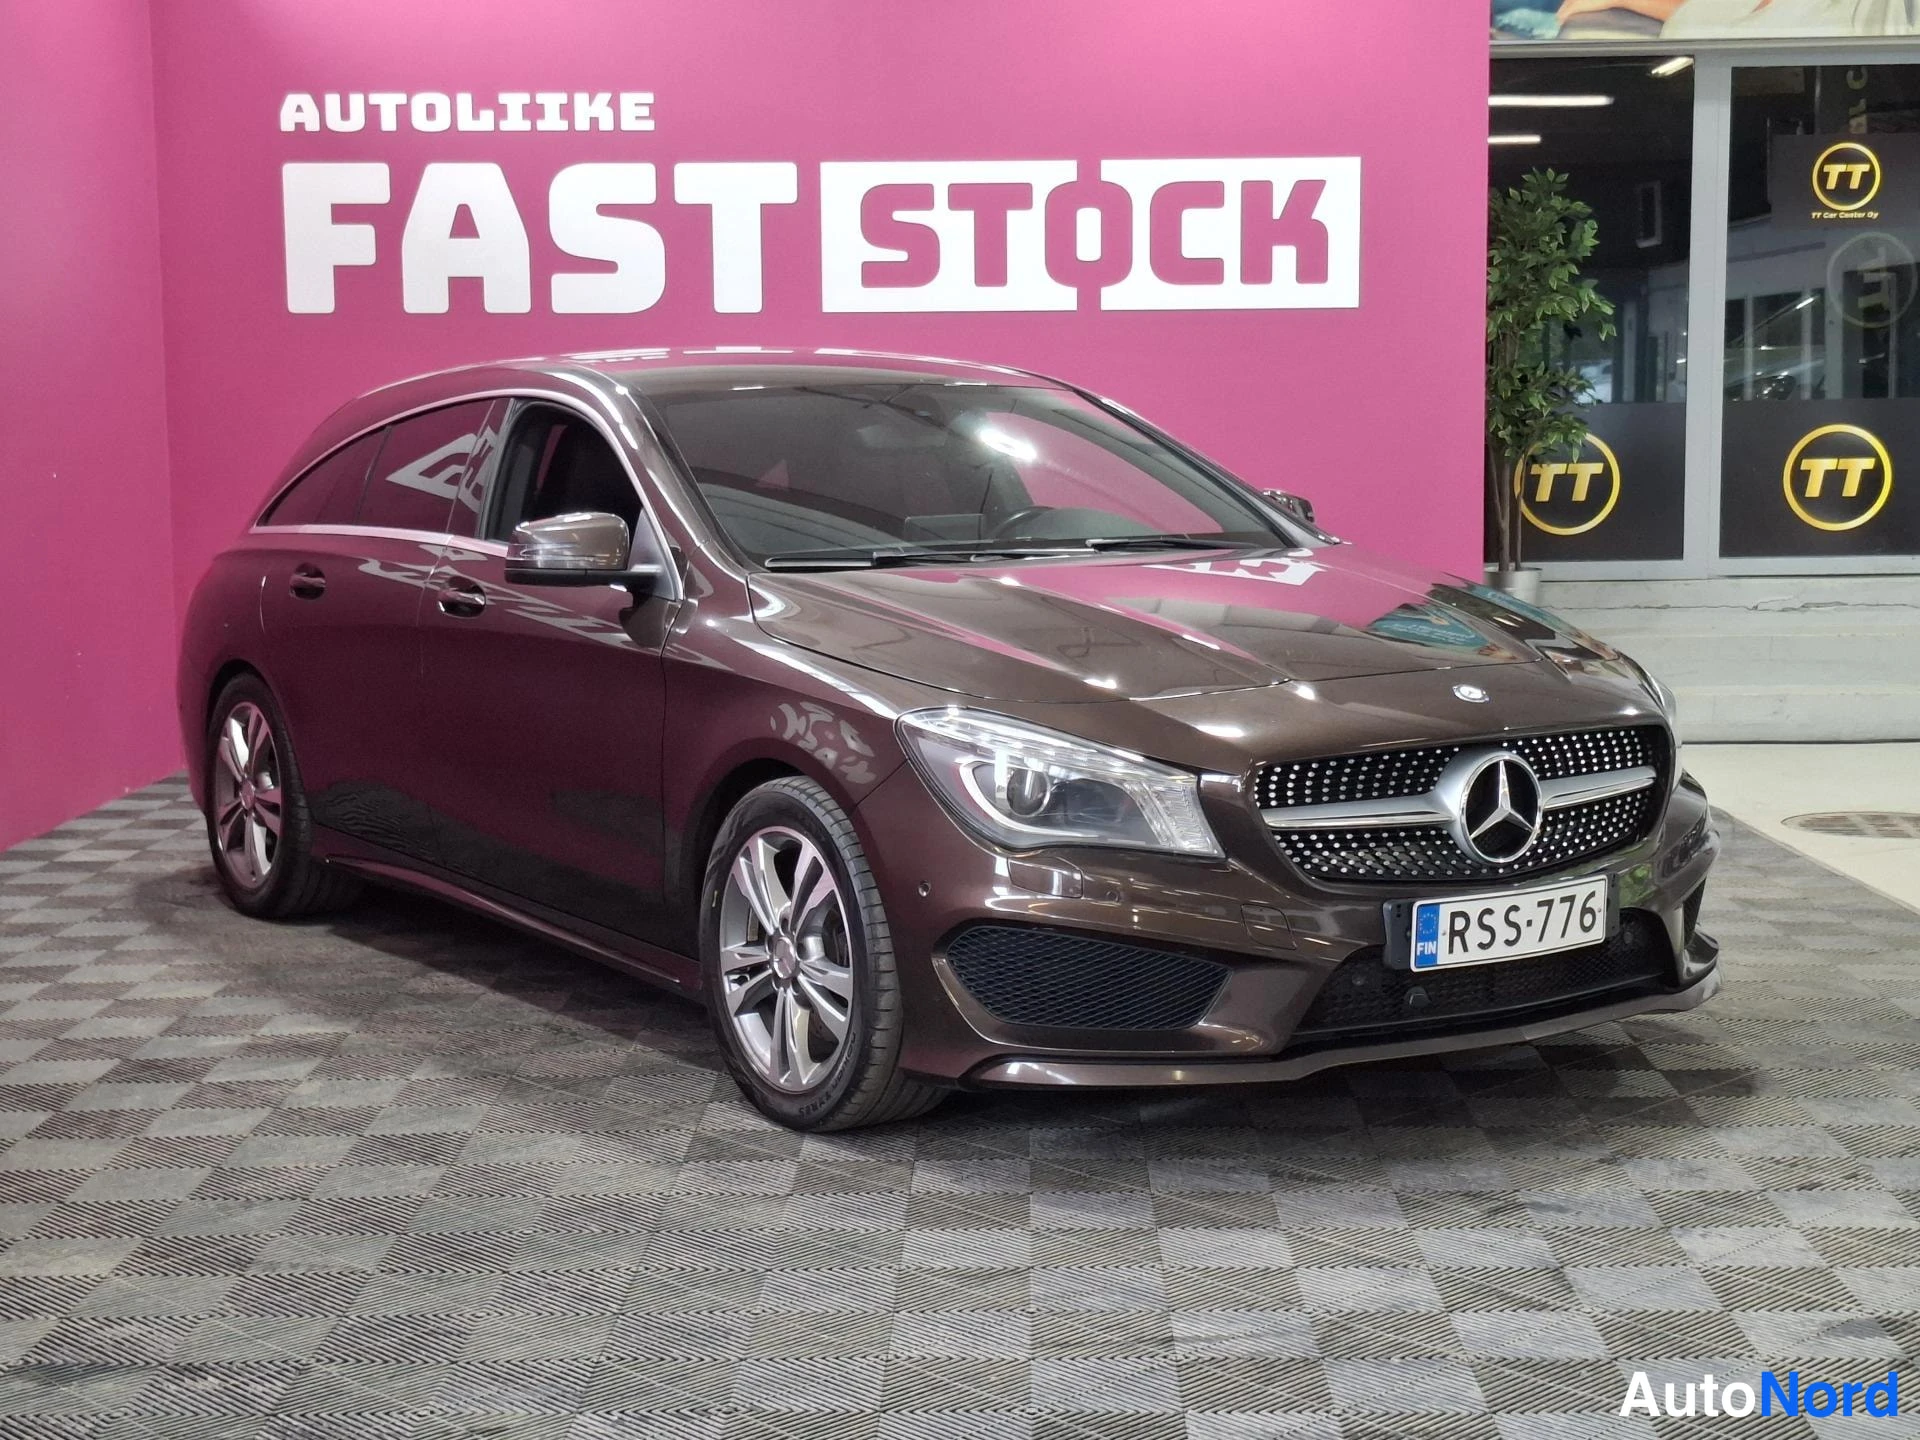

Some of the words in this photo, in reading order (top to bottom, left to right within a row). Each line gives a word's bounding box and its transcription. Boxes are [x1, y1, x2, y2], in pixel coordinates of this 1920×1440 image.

[280, 92, 655, 132] AUTOLIIKE
[1823, 163, 1871, 190] TT
[1811, 211, 1822, 219] TT
[1823, 211, 1837, 219] Car
[282, 162, 798, 314] FAST
[860, 179, 1329, 288] STOCK
[1530, 462, 1604, 502] TT
[1800, 457, 1876, 497] TT
[1448, 890, 1597, 955] RSS-776
[1416, 940, 1437, 956] FIN
